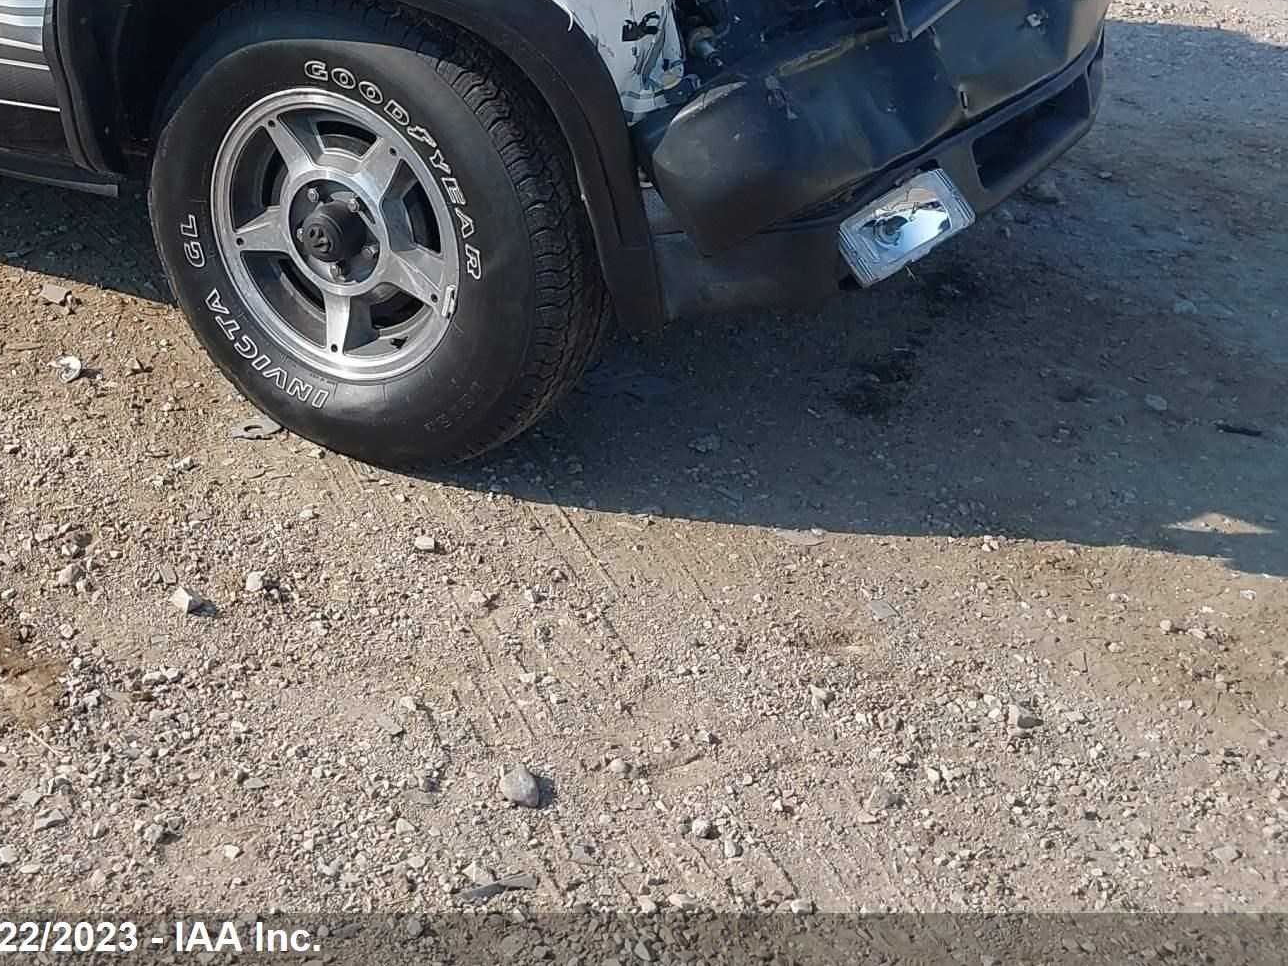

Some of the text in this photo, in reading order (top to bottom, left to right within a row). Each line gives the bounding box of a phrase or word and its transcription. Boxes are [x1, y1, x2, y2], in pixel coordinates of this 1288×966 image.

[303, 59, 483, 281] GOODYEAR
[179, 213, 331, 411] INVICTA GL
